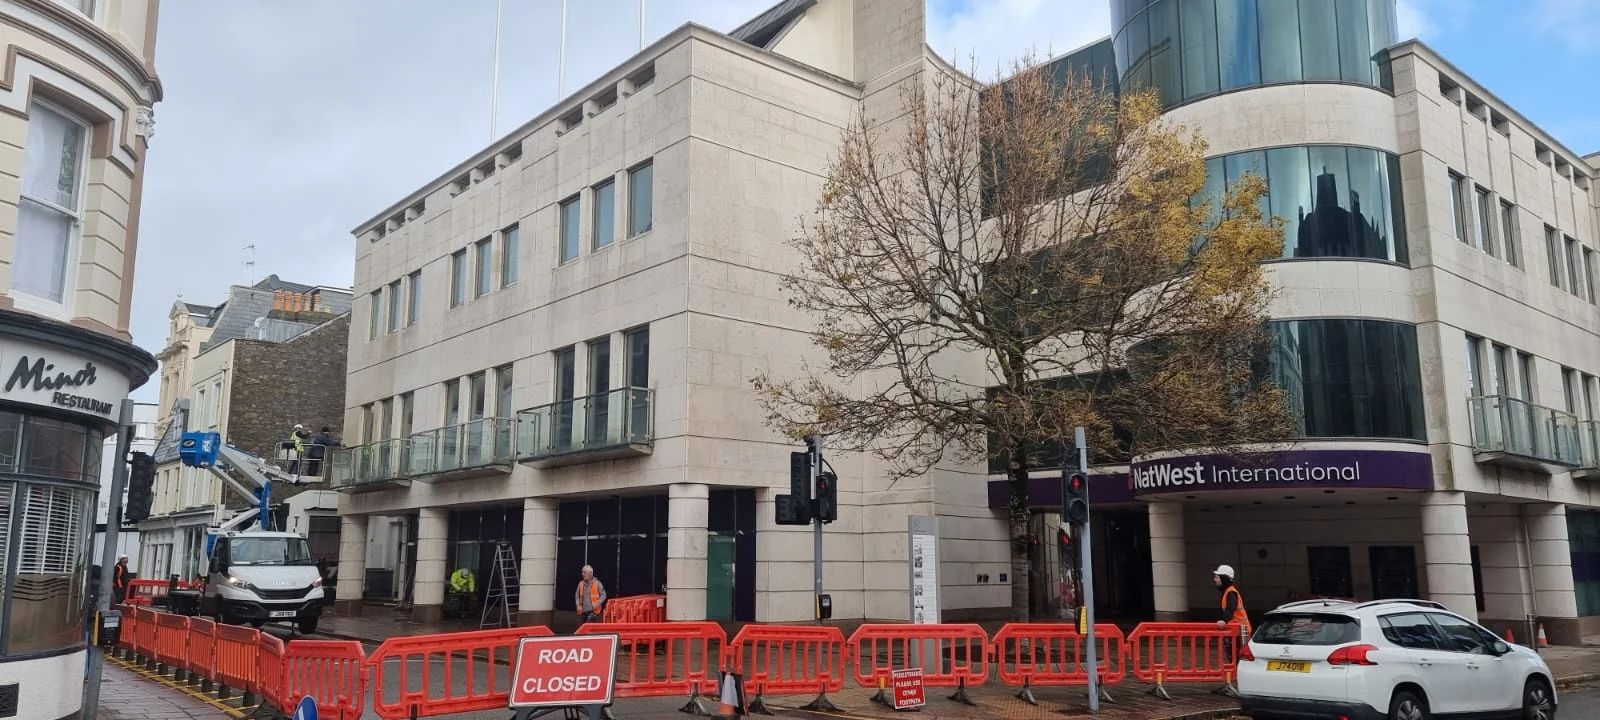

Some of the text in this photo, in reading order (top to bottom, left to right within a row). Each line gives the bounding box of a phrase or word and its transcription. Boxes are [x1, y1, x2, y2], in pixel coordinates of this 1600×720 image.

[52, 391, 114, 415] RESTAURANT
[1133, 461, 1361, 489] NatWest International
[538, 648, 593, 664] ROAD
[523, 676, 601, 693] CLOSED
